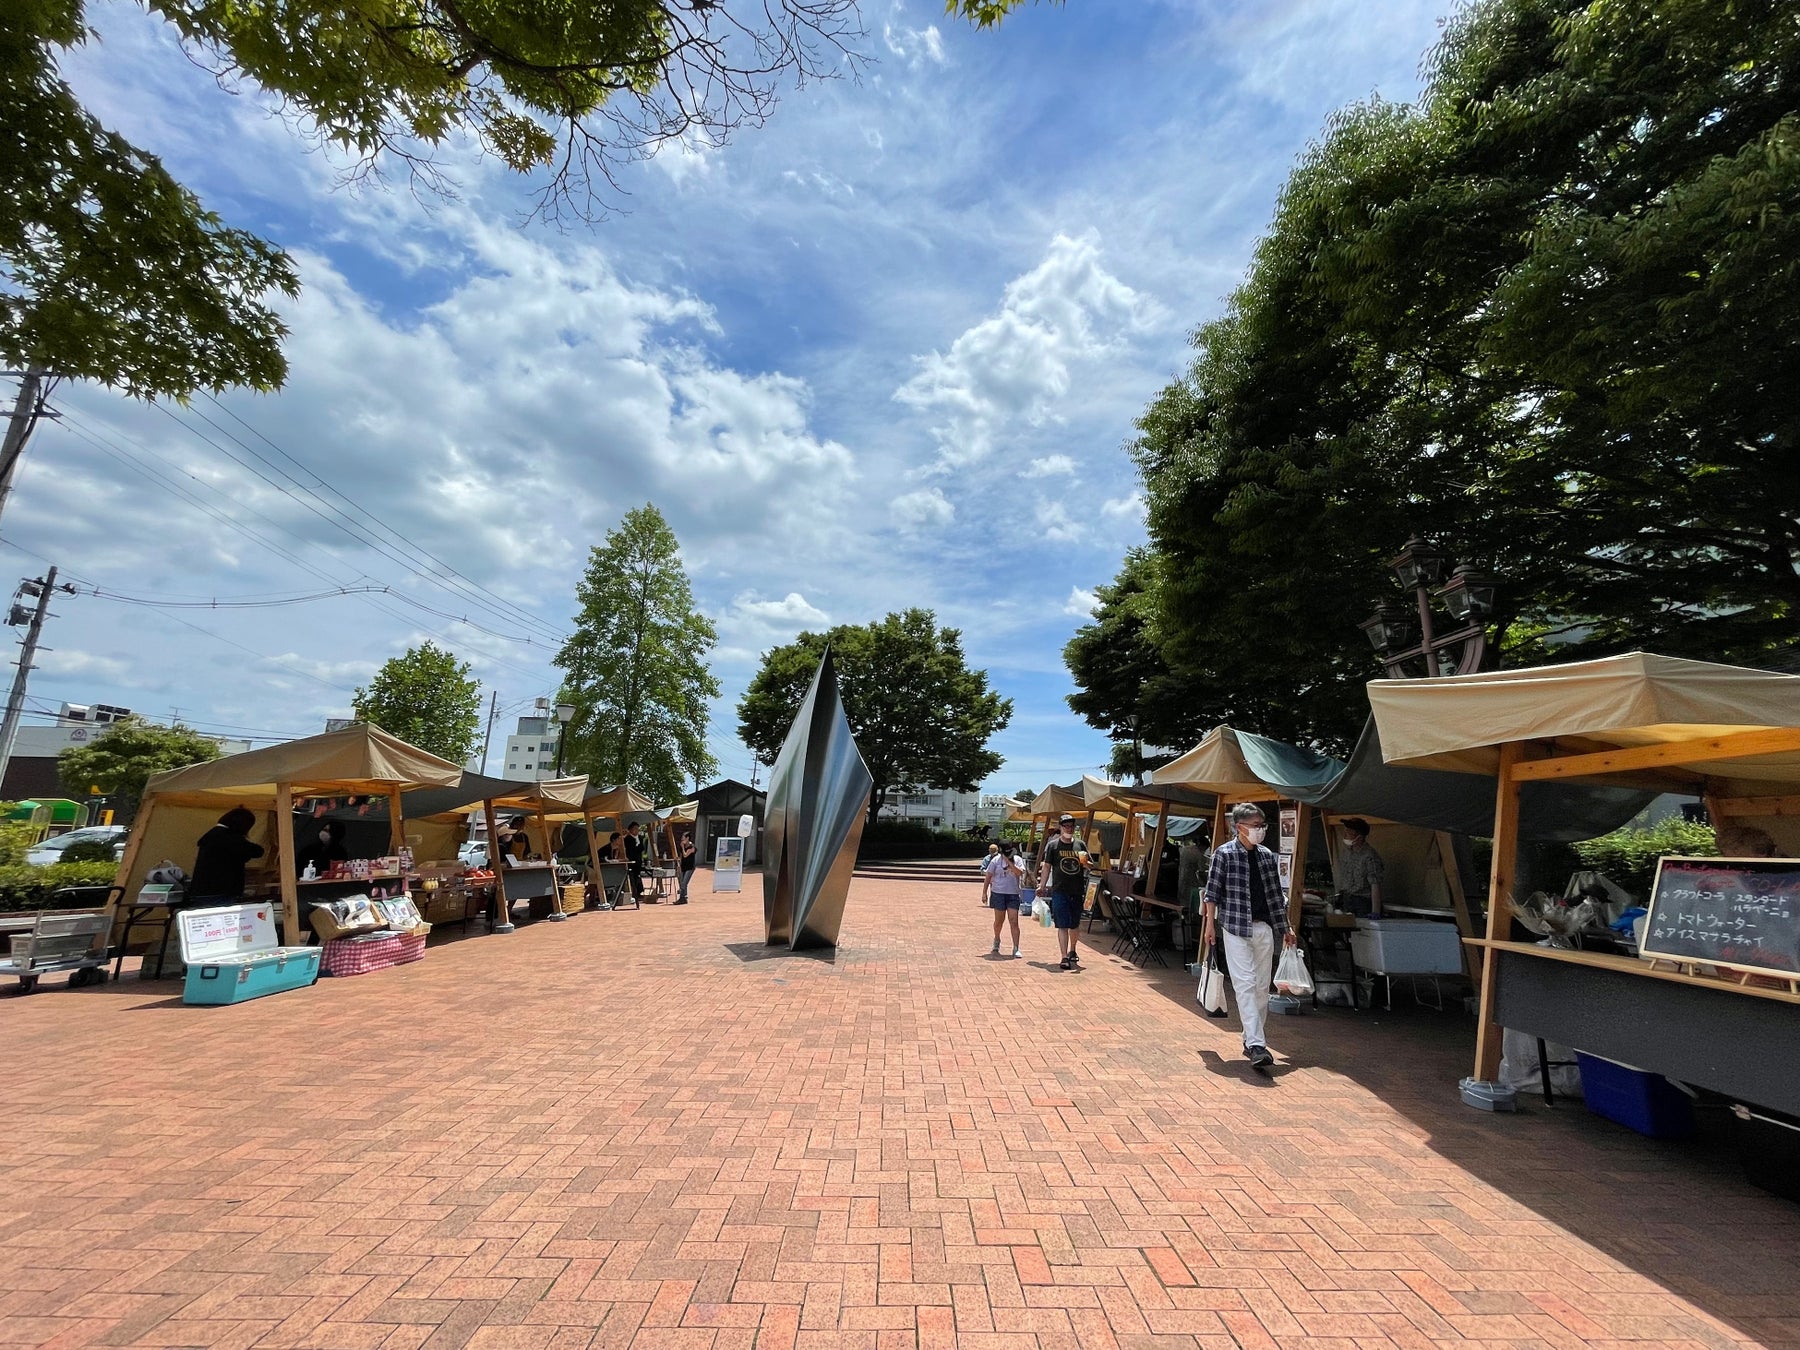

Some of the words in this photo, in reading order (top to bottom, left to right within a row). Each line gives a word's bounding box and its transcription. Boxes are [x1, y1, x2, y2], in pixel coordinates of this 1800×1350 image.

[1673, 889, 1725, 901] クラフトコーラ
[1678, 912, 1757, 930] トマトウォーター
